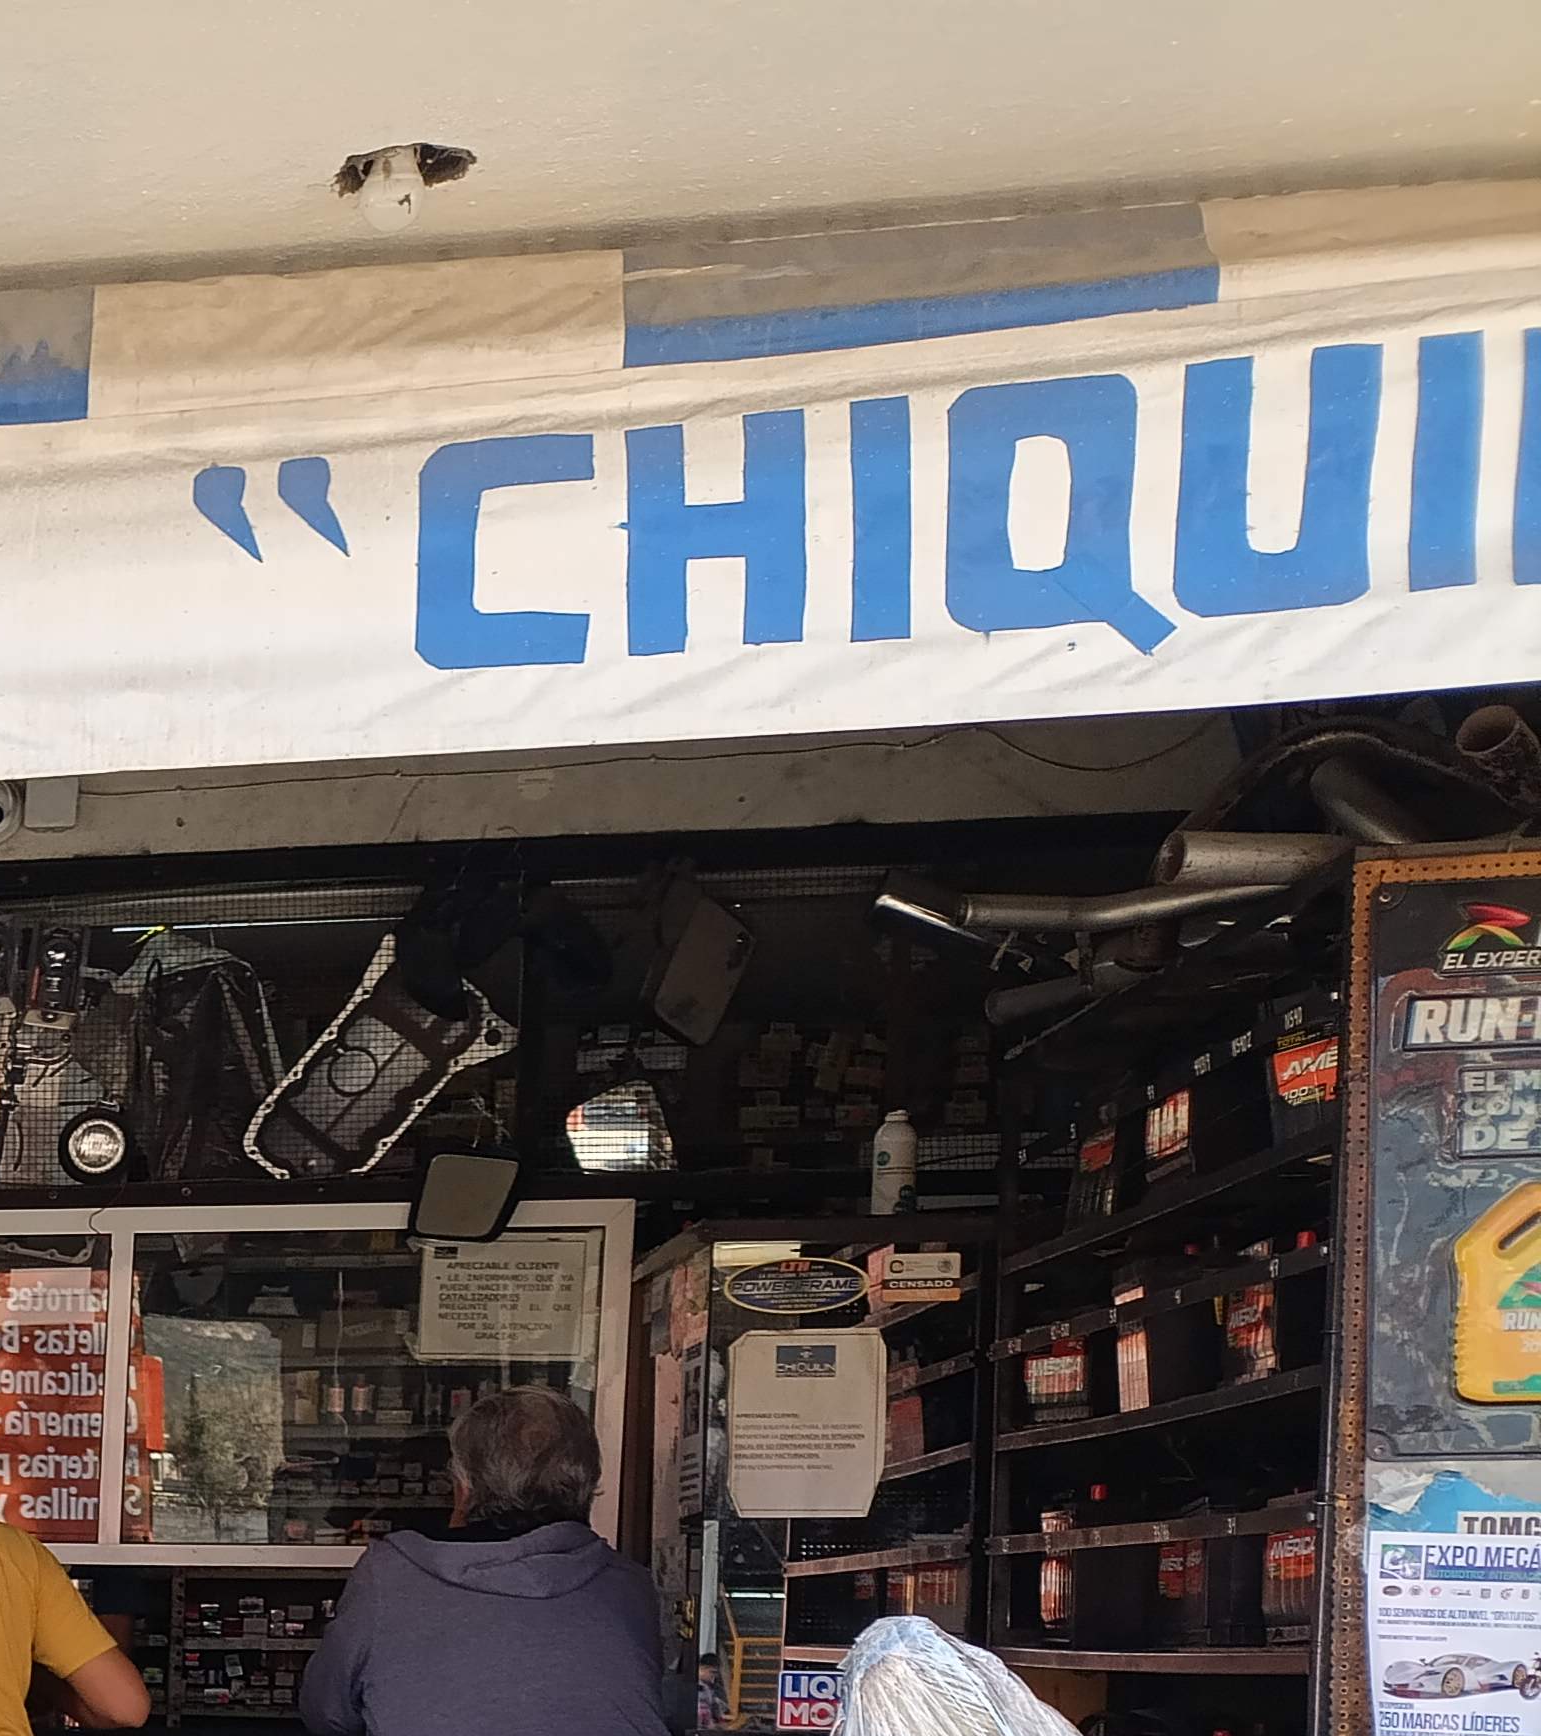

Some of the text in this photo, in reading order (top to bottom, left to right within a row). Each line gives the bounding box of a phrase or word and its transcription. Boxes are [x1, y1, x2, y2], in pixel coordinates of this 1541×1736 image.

[193, 328, 1541, 669] “CHIQUI
[1443, 949, 1541, 970] EL EXPER
[1464, 1071, 1505, 1093] EL
[1464, 1096, 1535, 1117] CON
[1462, 1121, 1530, 1151] DE
[447, 1262, 560, 1270] APRECIABLE CLIENTE
[889, 1280, 954, 1289] CENSADO
[1426, 1543, 1541, 1569] EXPO MECÁ
[1402, 1713, 1460, 1731] MARCAS
[1462, 1711, 1521, 1733] LÍDERES
